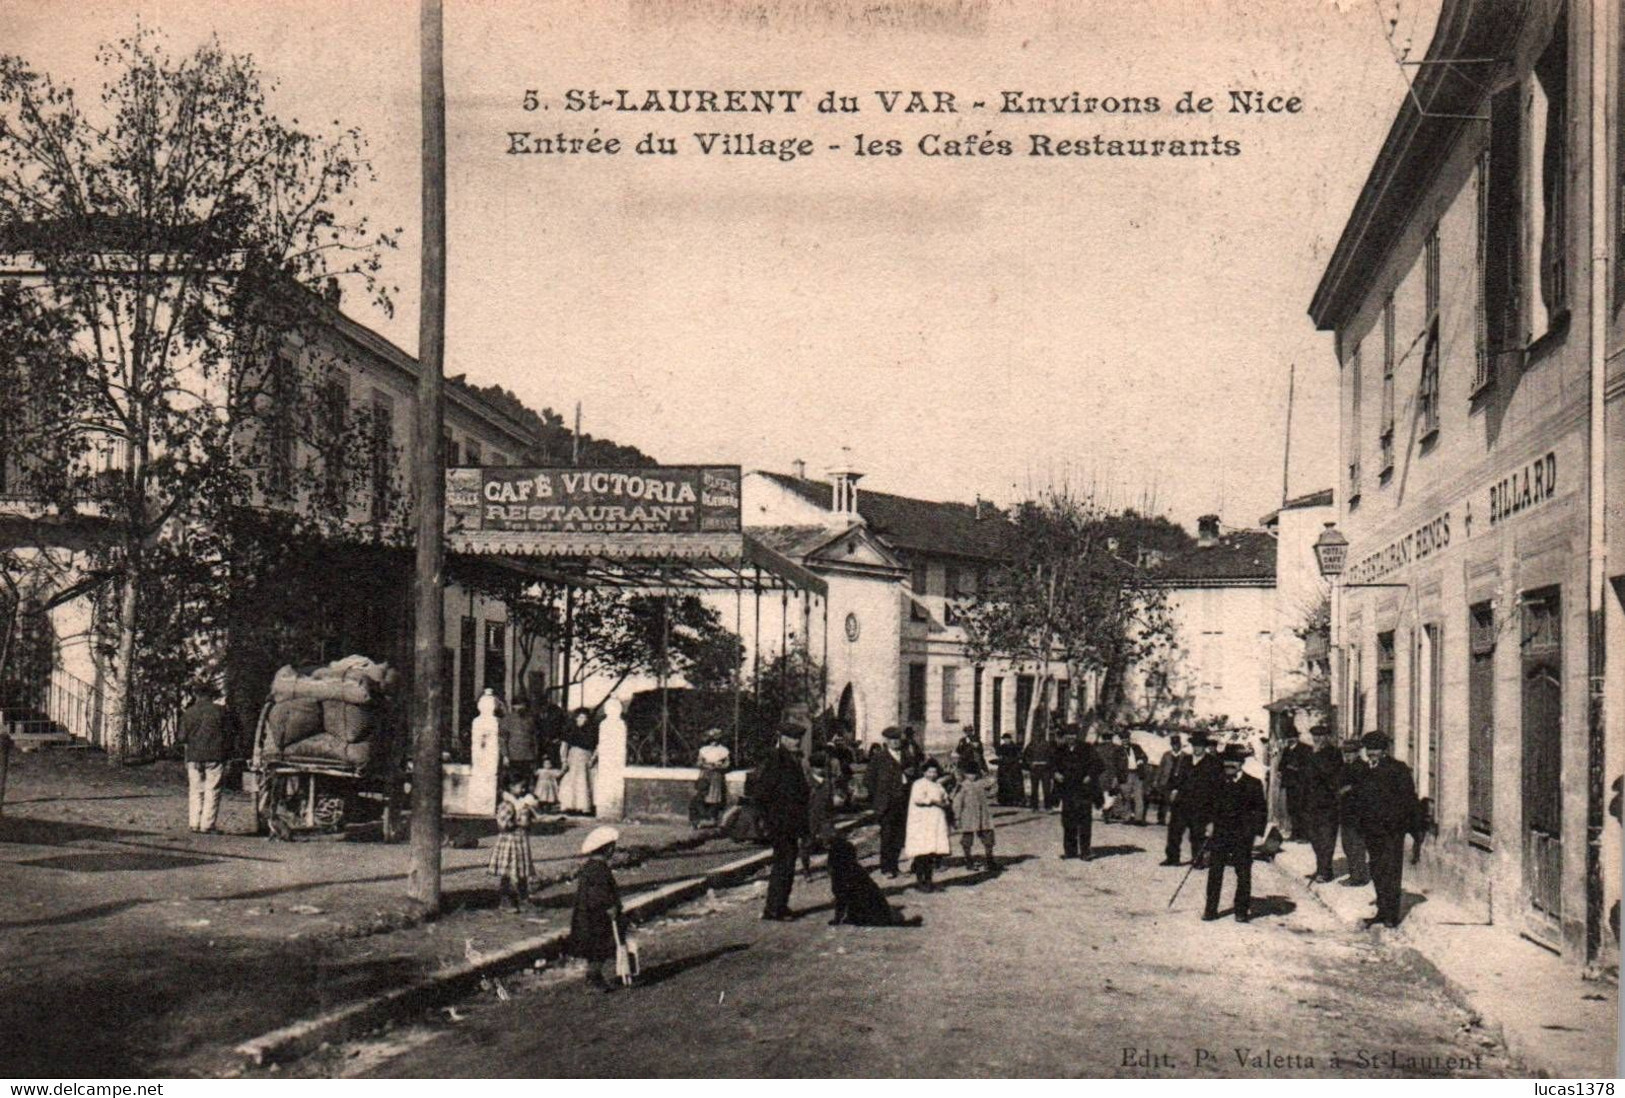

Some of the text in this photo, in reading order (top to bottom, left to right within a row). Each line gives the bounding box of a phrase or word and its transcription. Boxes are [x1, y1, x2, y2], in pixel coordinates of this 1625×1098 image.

[561, 472, 697, 503] VICTORIA
[1490, 451, 1556, 525] BILLARD
[485, 504, 695, 522] RESTAURANT
